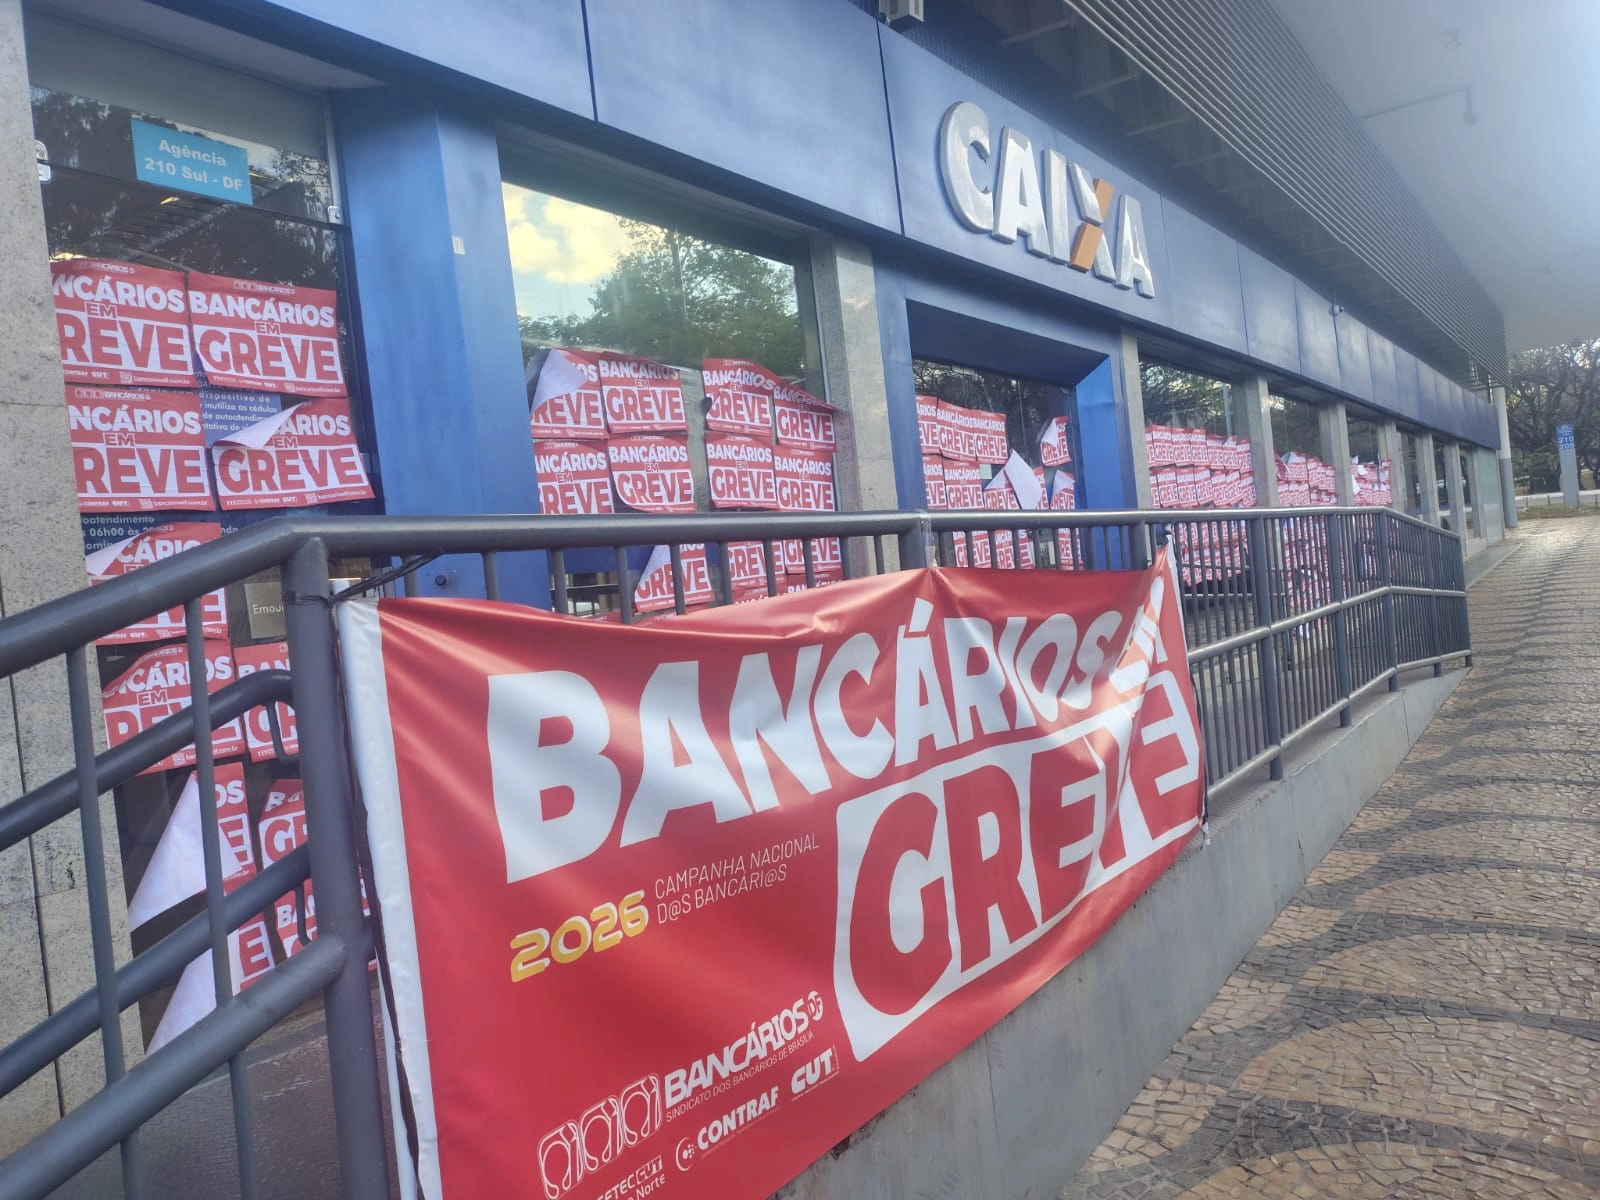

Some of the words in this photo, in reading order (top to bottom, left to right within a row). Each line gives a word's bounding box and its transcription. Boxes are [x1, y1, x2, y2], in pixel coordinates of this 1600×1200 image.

[159, 139, 226, 166] Agência
[144, 156, 176, 175] 210
[181, 165, 208, 184] Sul
[222, 175, 243, 191] DF
[939, 101, 1155, 299] CAIXA
[86, 303, 118, 318] EM
[188, 290, 335, 328] BANCÁRIOS
[56, 312, 189, 372] REVE
[256, 321, 280, 335] EM
[199, 329, 339, 381] GREVE
[702, 367, 776, 391] BANCÁRIOS
[68, 403, 202, 435] NCÁRIOS
[203, 410, 213, 420] de
[205, 400, 236, 411] inutiliza
[606, 388, 684, 422] GREVE
[104, 433, 134, 446] EM
[777, 408, 833, 442] GREVE
[273, 437, 298, 449] EM
[608, 444, 688, 464] BANCÁRIOS
[706, 443, 773, 463] BANCÁRIOS
[939, 427, 975, 456] GREVE
[976, 434, 1007, 458] GREVE
[73, 447, 206, 494] REVE
[219, 450, 364, 494] GREVE
[774, 455, 832, 476] BANCÁRIOS
[542, 481, 611, 514] REVE
[617, 472, 692, 505] GREVE
[712, 468, 776, 499] GREVE
[778, 479, 831, 510] GREVE
[948, 486, 982, 509] GREVE
[89, 527, 124, 537] 06h00
[137, 690, 167, 706] EM
[488, 597, 1122, 884] BANCÁRIOS
[655, 855, 746, 900] CAMPANHA
[750, 832, 820, 870] NACIONAL
[657, 893, 692, 925] D@S
[510, 889, 649, 983] 2026
[664, 998, 809, 1109] BANCÁRIOS
[666, 1090, 711, 1123] SINDICATO
[713, 1079, 731, 1097] DOS
[732, 1055, 778, 1087] BANCÁRIOS
[778, 1047, 788, 1062] DE
[788, 1030, 814, 1055] BRASÍLIA
[791, 1048, 833, 1094] CUT
[697, 1085, 779, 1151] CONTRAF
[635, 1173, 666, 1200] Norte
